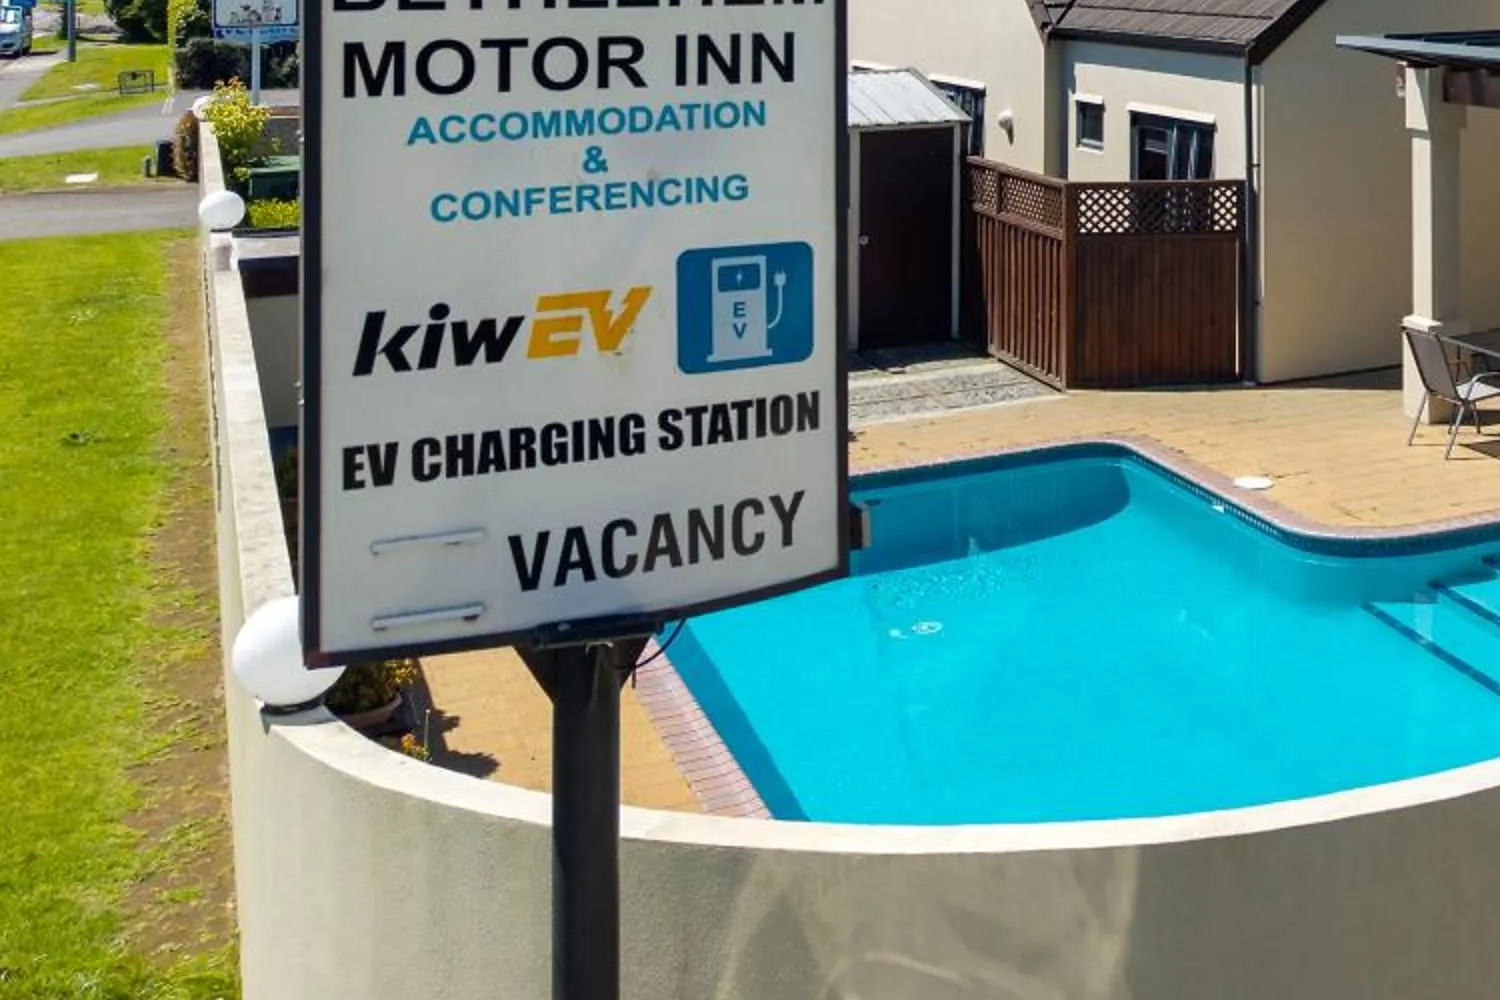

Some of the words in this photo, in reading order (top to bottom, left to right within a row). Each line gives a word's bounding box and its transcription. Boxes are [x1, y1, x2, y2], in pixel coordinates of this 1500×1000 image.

[343, 36, 648, 98] MOTOR
[675, 32, 794, 86] INN
[408, 101, 766, 146] ACCOMMODATION
[582, 146, 608, 173] &
[431, 175, 748, 222] CONFERENCING
[342, 442, 399, 491] EV
[412, 413, 645, 482] CHARGING
[658, 390, 819, 451] STATION
[507, 491, 805, 592] VACANCY
